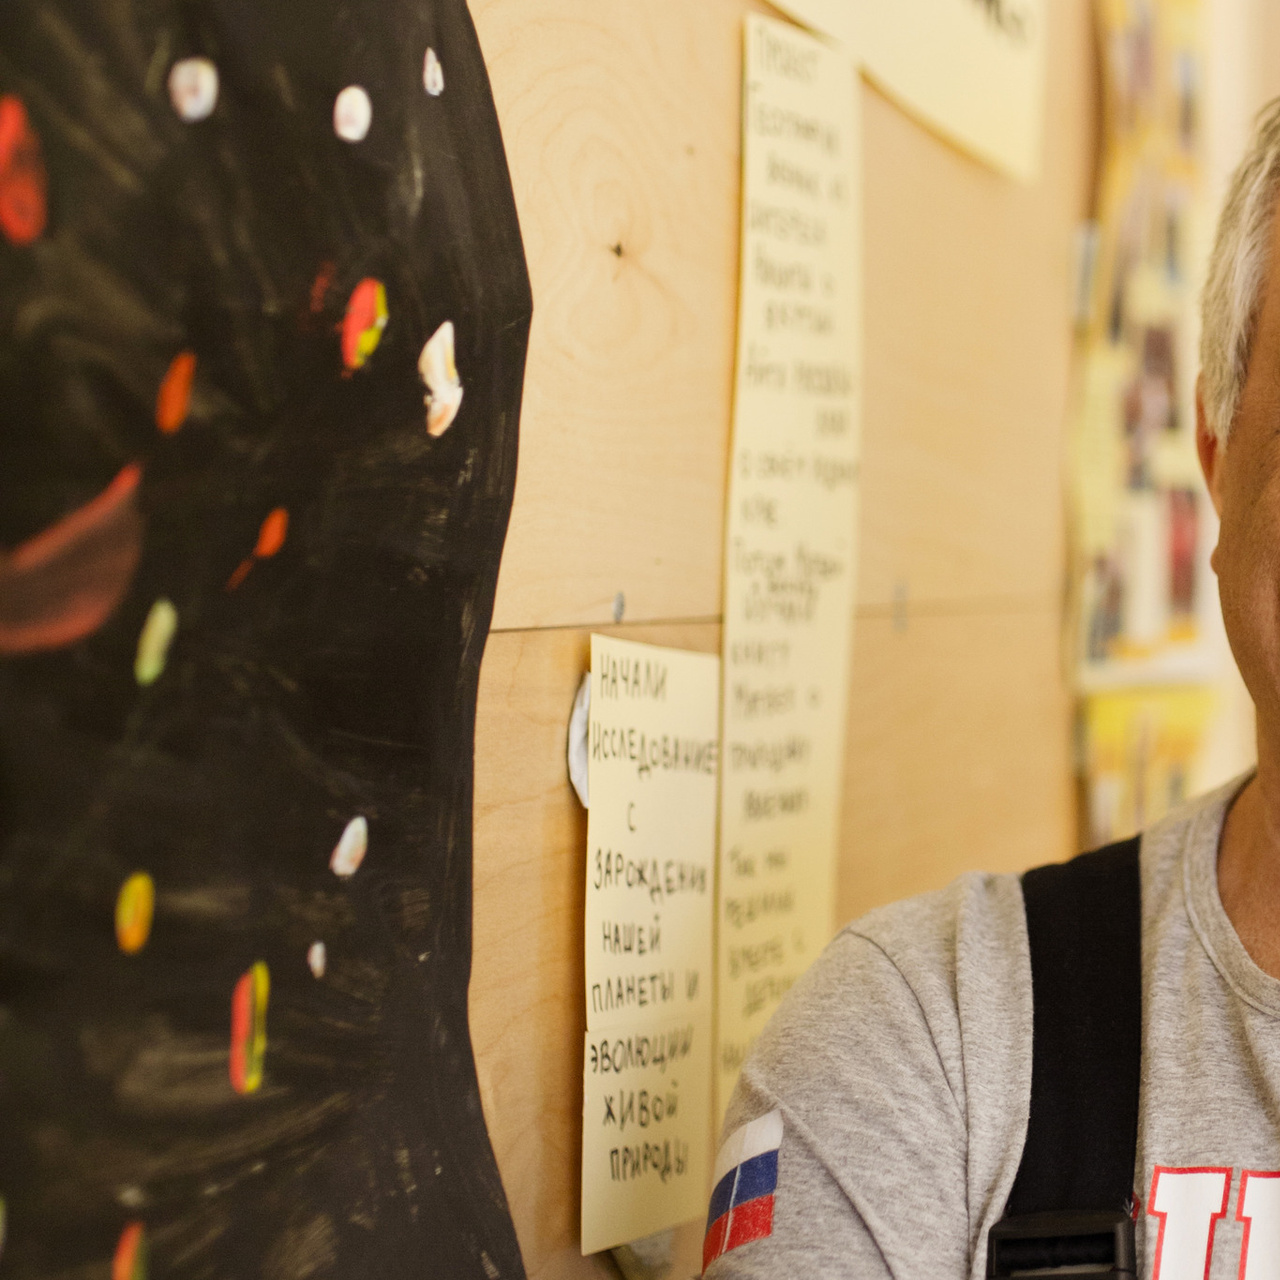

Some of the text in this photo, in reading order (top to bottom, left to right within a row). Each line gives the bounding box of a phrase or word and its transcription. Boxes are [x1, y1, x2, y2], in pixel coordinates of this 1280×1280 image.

[600, 652, 669, 701] НАЧАЛИ
[592, 721, 718, 781] ИССЛЕДОВАНИЕ
[602, 914, 662, 956] НАШЕЙ
[592, 972, 675, 1013] ПЛАНЕТЫ
[603, 1078, 679, 1131] ЖИВОЙ
[610, 1136, 689, 1183] ПРИРОДЫ
